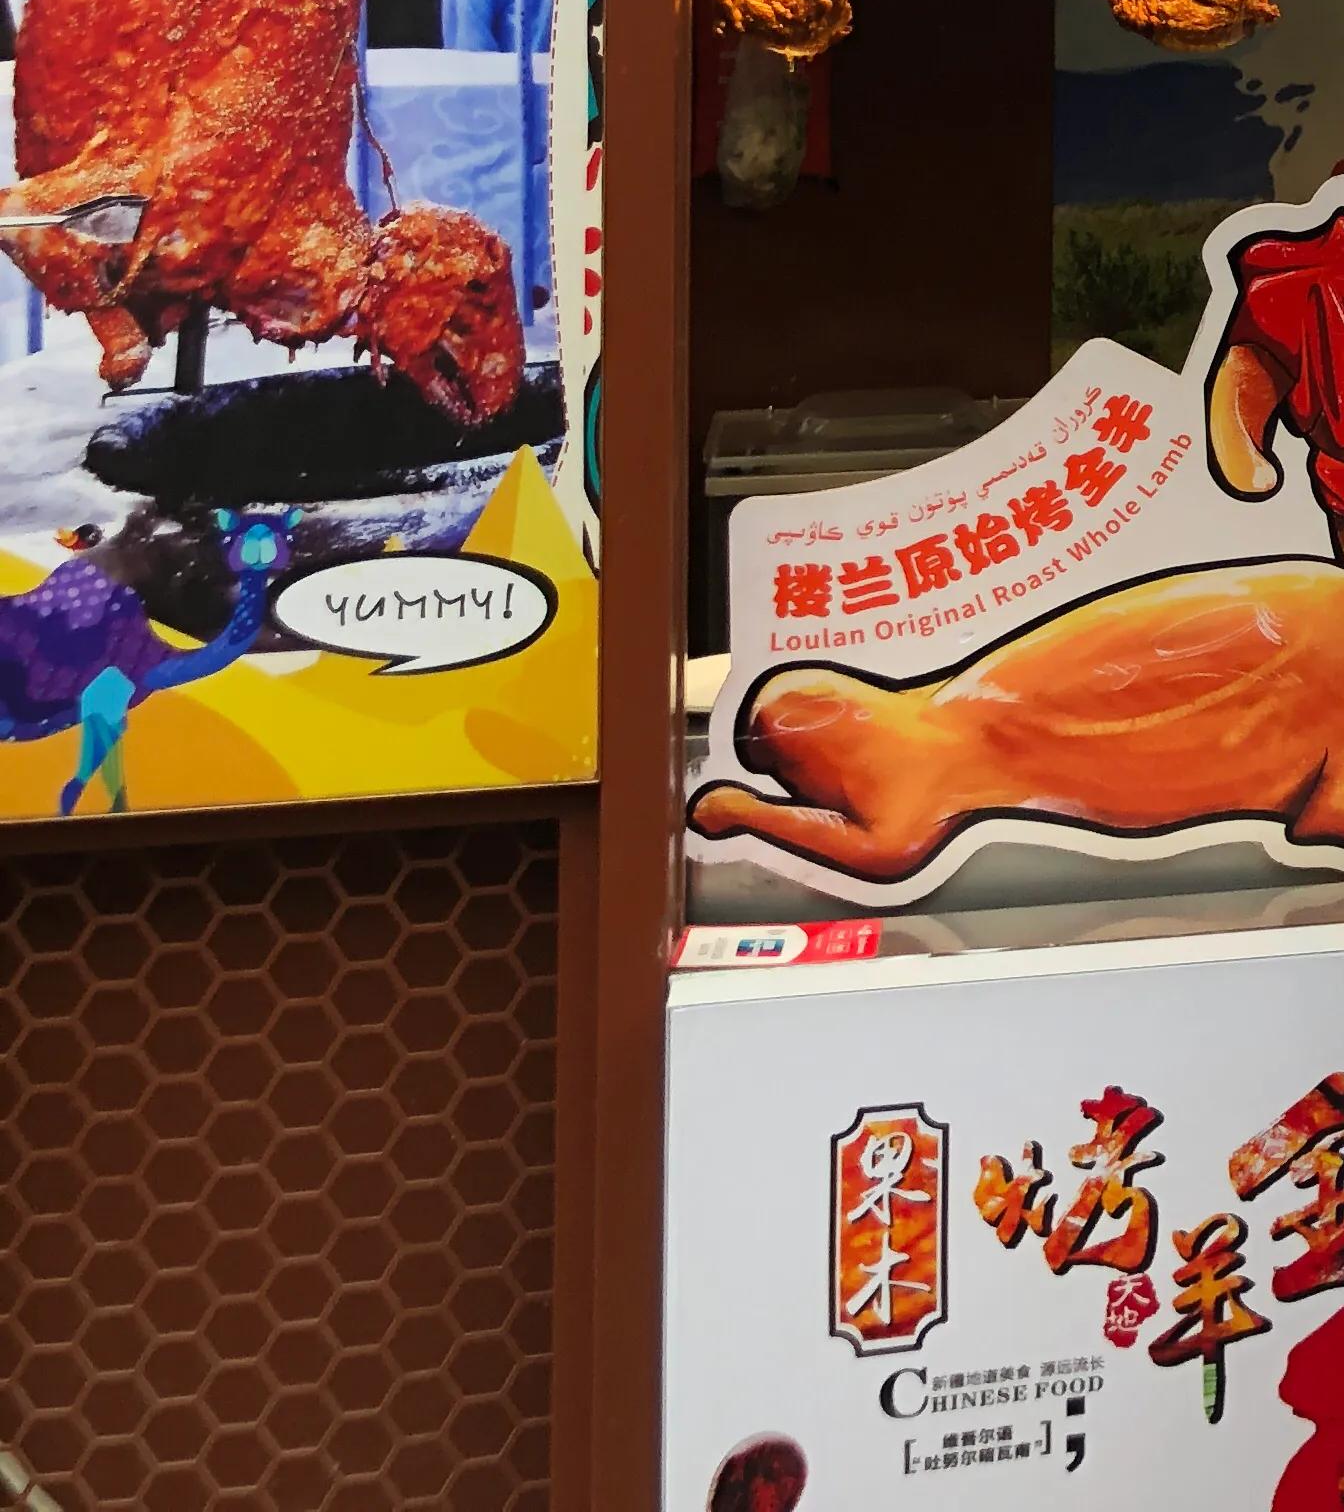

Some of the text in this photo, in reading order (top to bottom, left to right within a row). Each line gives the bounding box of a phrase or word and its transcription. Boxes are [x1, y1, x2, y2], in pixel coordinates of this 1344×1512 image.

[769, 433, 1193, 652] Loulan Original Roast Whole Lamb
[773, 393, 1155, 619] 楼兰原始烤全羊
[325, 582, 514, 626] YUMMY!
[848, 1131, 932, 1326] 果木
[879, 1366, 1105, 1419] CHINESE FOOD
